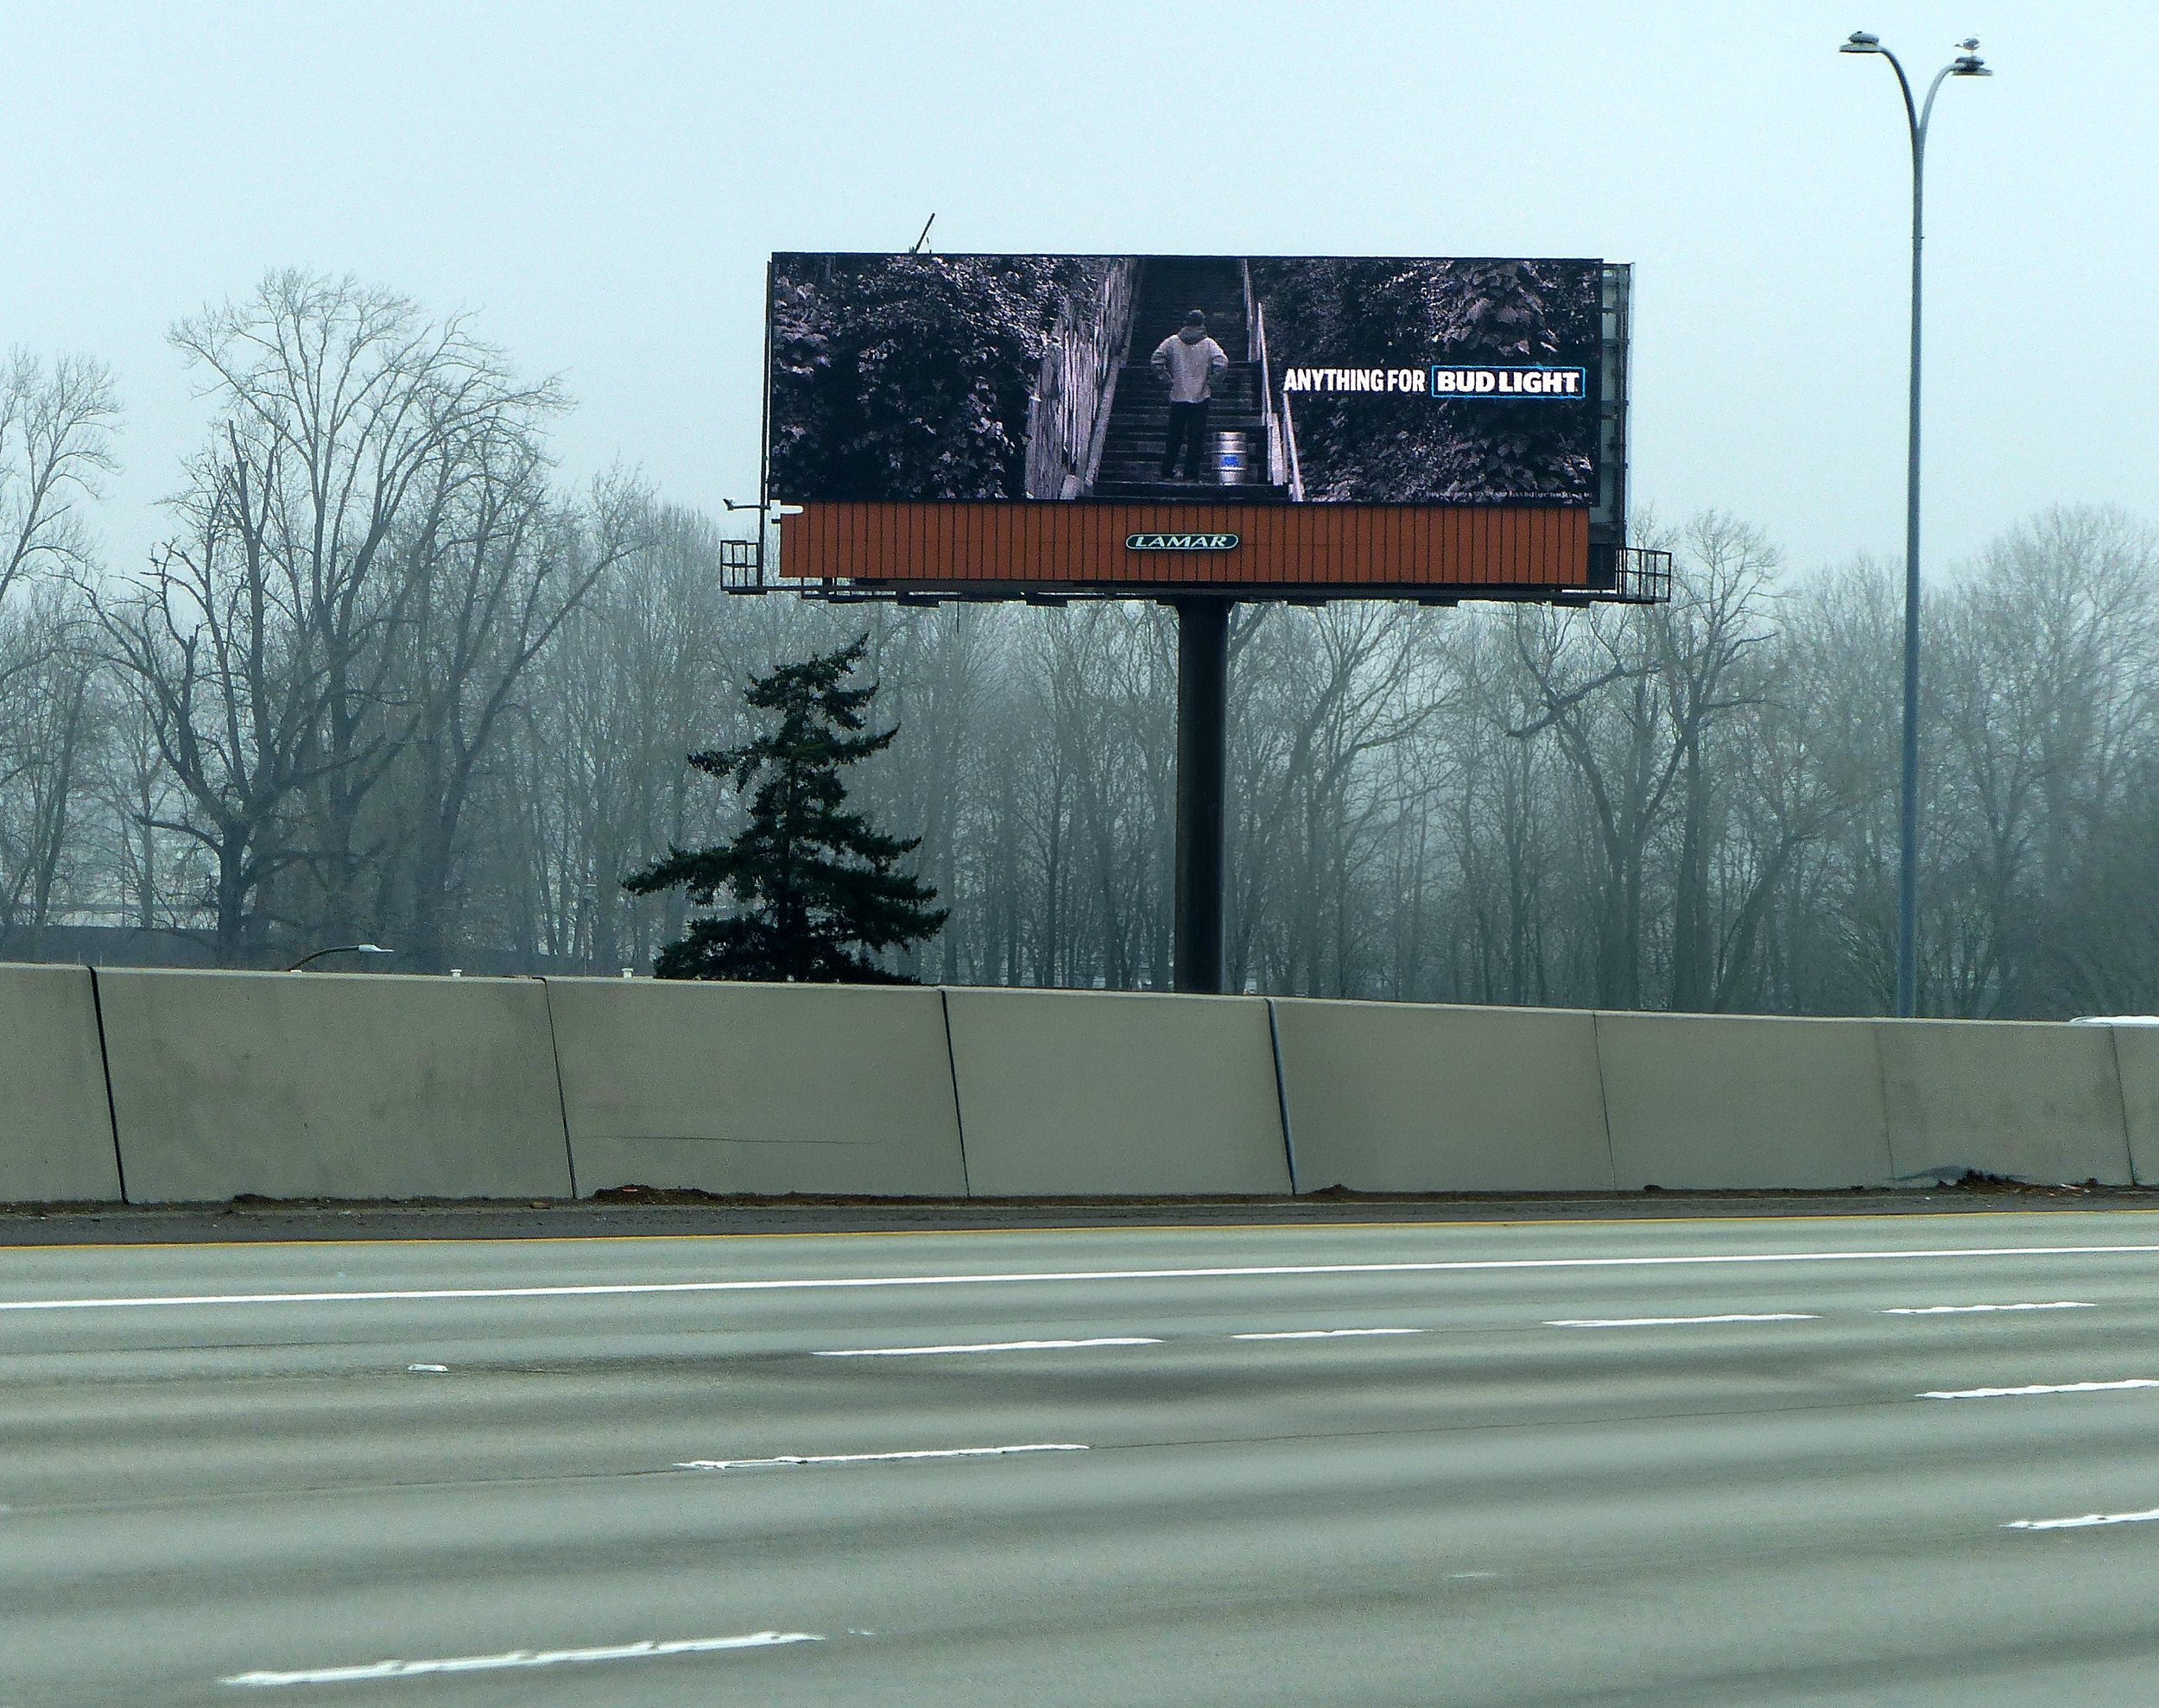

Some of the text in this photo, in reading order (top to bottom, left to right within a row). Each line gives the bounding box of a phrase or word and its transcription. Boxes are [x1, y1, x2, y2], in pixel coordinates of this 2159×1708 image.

[1283, 368, 1580, 393] ANYTHING FOR BUD LIGHT
[1135, 536, 1228, 547] LAMAR
